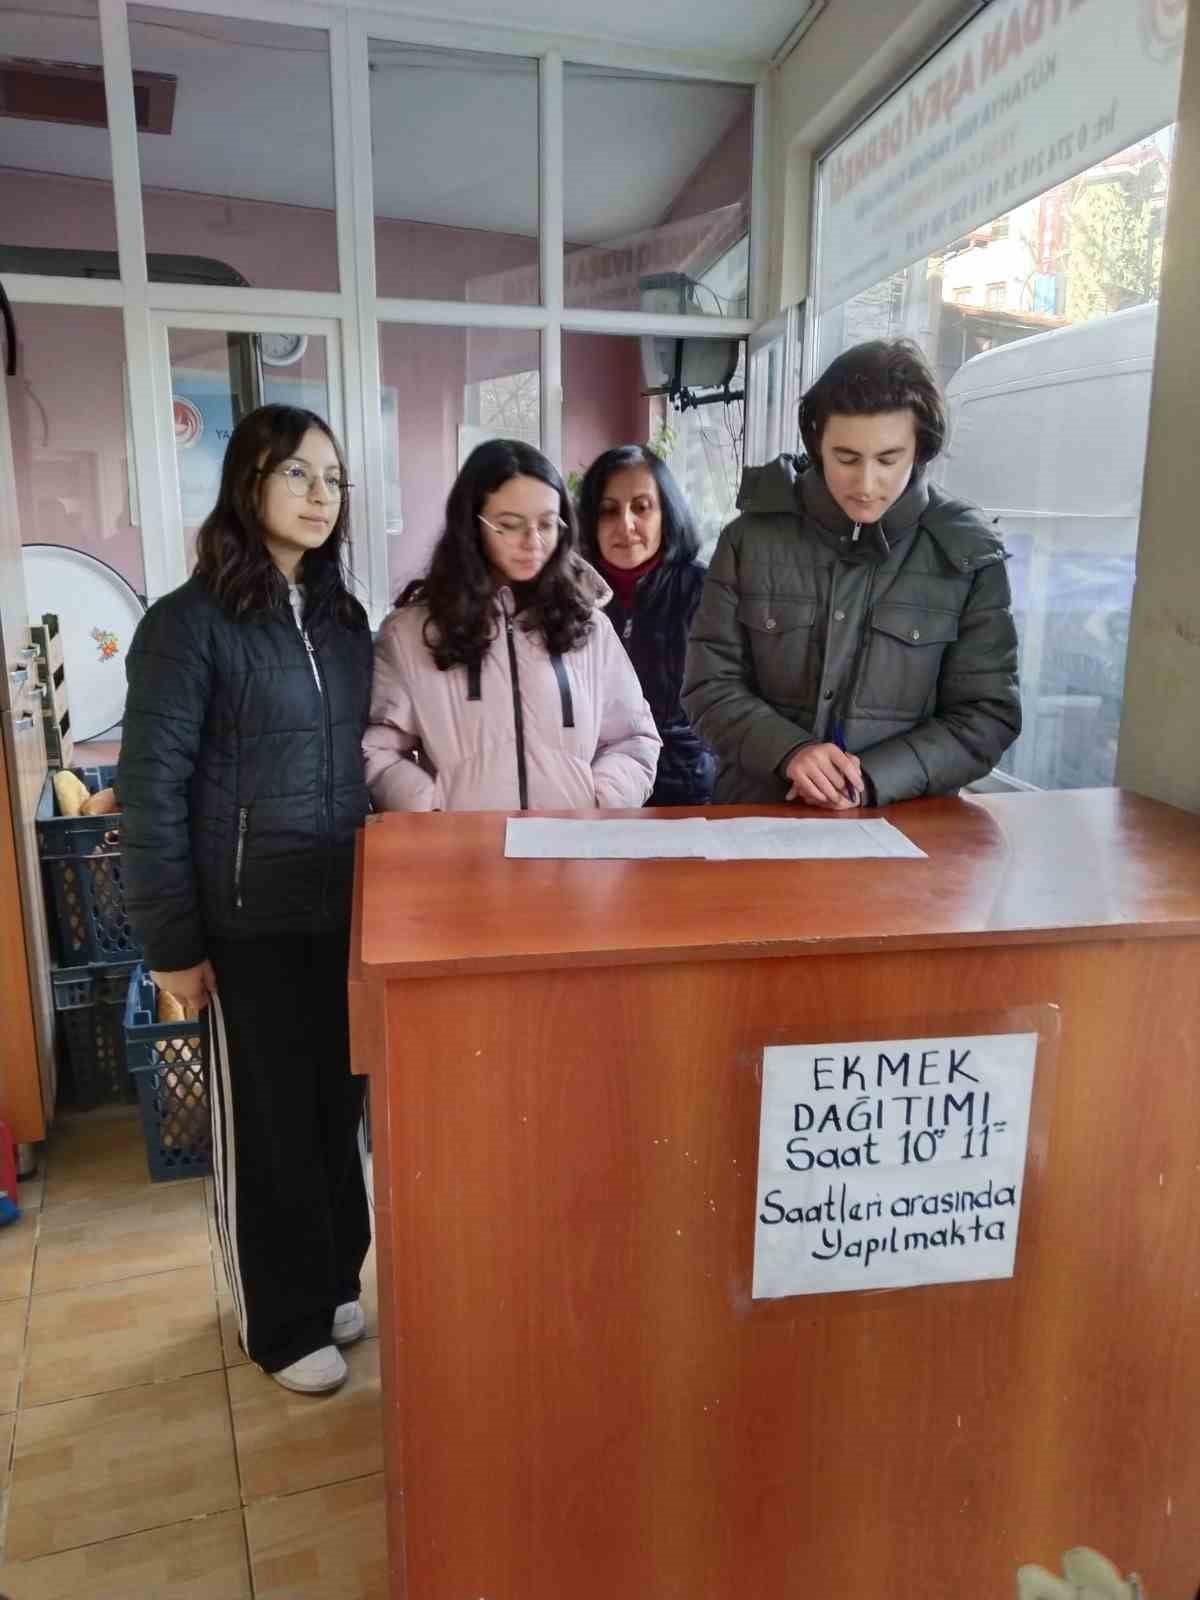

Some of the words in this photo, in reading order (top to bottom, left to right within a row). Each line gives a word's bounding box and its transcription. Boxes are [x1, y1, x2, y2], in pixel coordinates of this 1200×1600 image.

[814, 1049, 980, 1091] EKMEK
[794, 1091, 990, 1133] DAĞITIMI
[786, 1133, 880, 1171] Saat
[890, 1180, 1016, 1217] arasında
